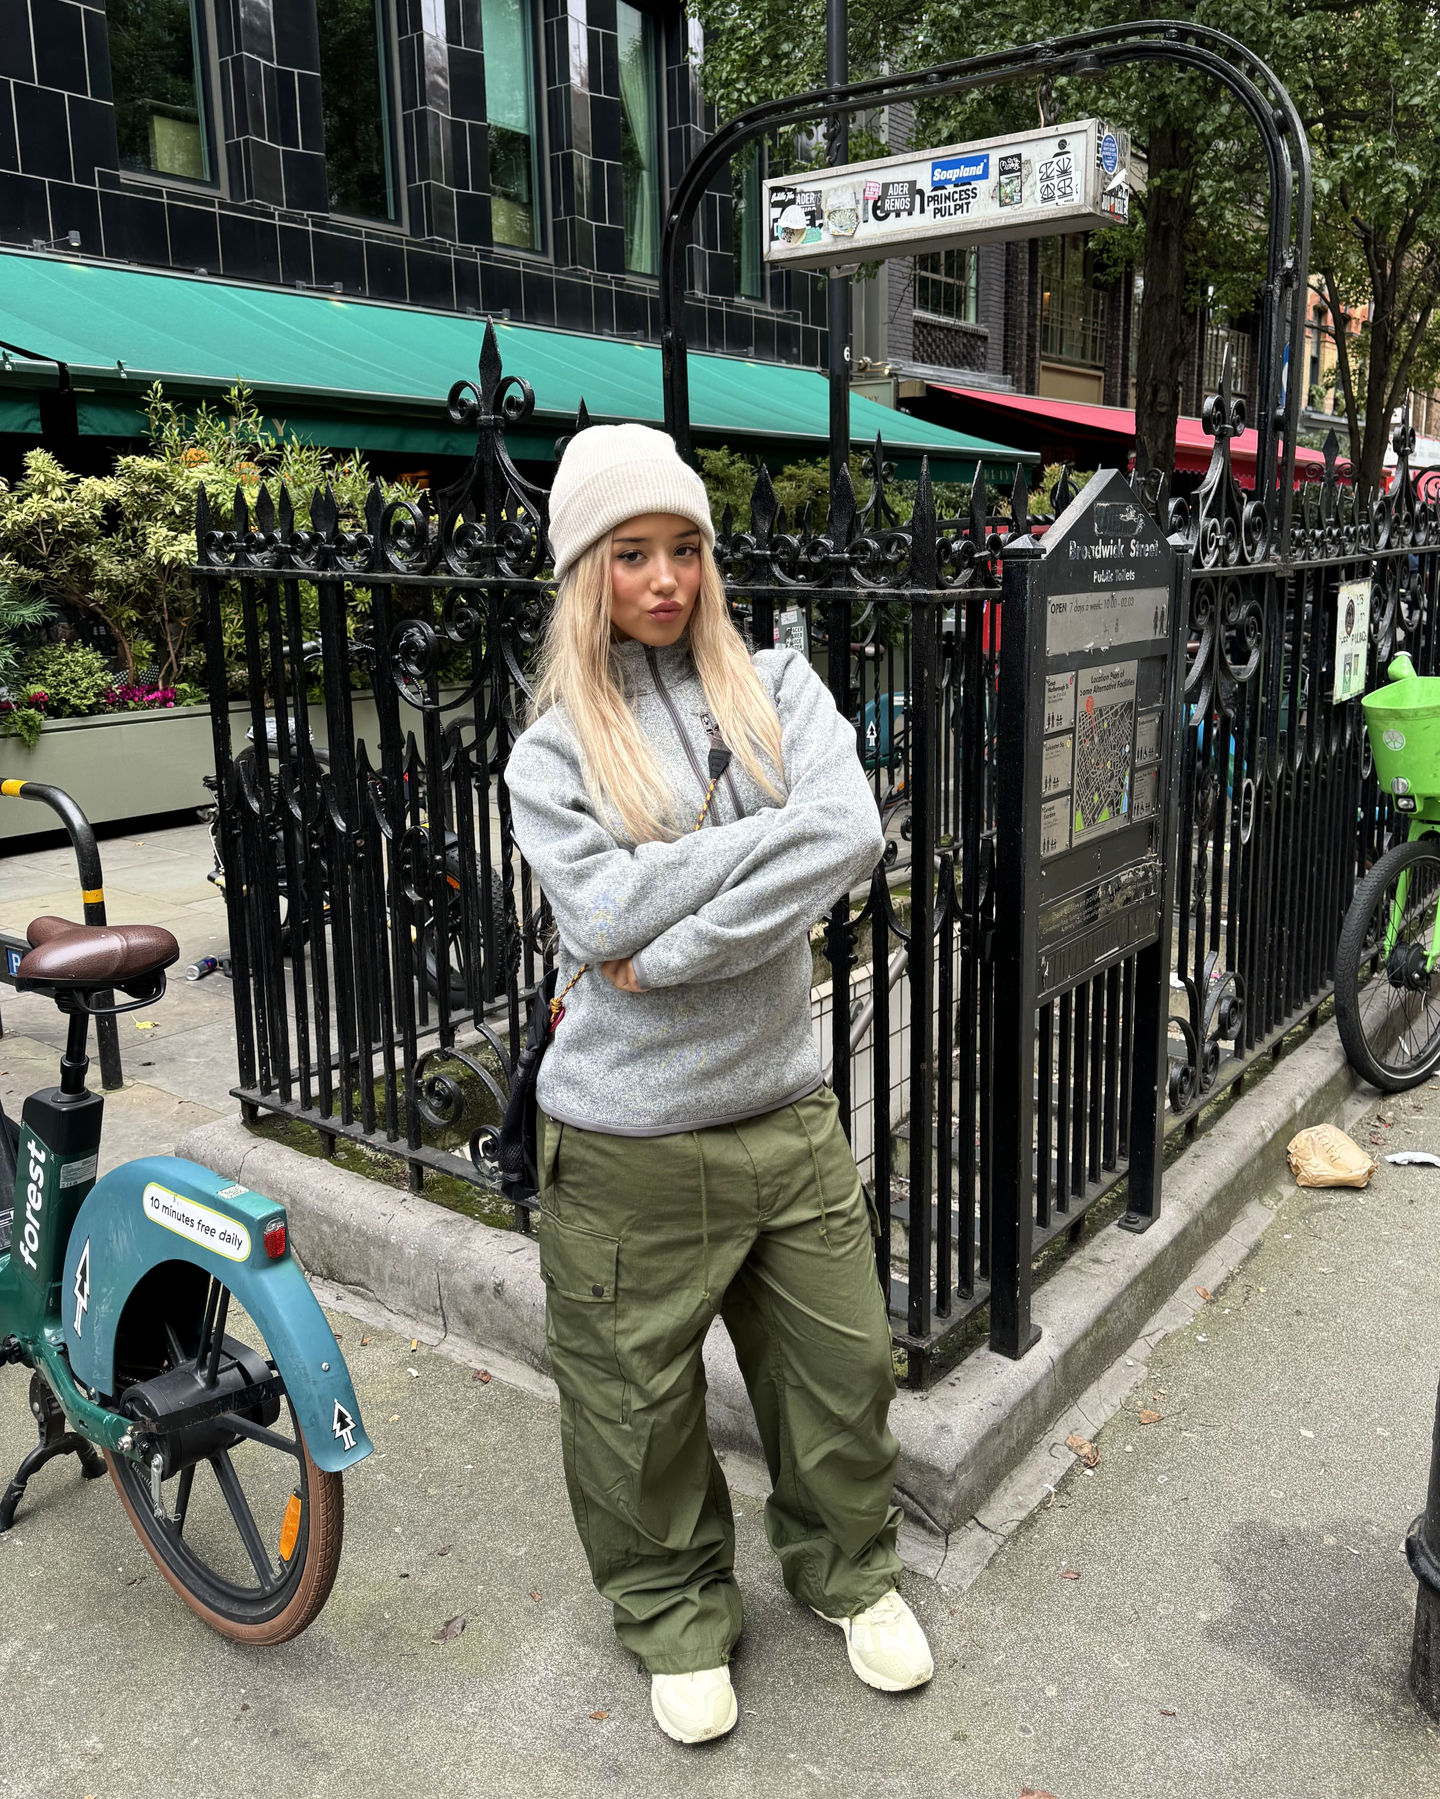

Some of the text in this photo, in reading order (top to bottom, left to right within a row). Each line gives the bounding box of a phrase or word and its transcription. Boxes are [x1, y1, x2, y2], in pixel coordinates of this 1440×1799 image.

[933, 163, 984, 181] Soapland
[888, 183, 909, 196] ADER
[927, 187, 978, 207] PRINCESS
[796, 192, 815, 205] ADER
[885, 198, 911, 211] RENOS
[933, 201, 971, 219] PULPIT
[844, 346, 850, 361] 6
[1050, 602, 1067, 614] OPEN
[1069, 602, 1074, 613] 7
[1093, 681, 1116, 694] Alternative
[1117, 677, 1135, 689] Facilities
[12, 953, 21, 973] P
[20, 1139, 46, 1270] forest
[150, 1196, 243, 1251] 10 minutes free daily
